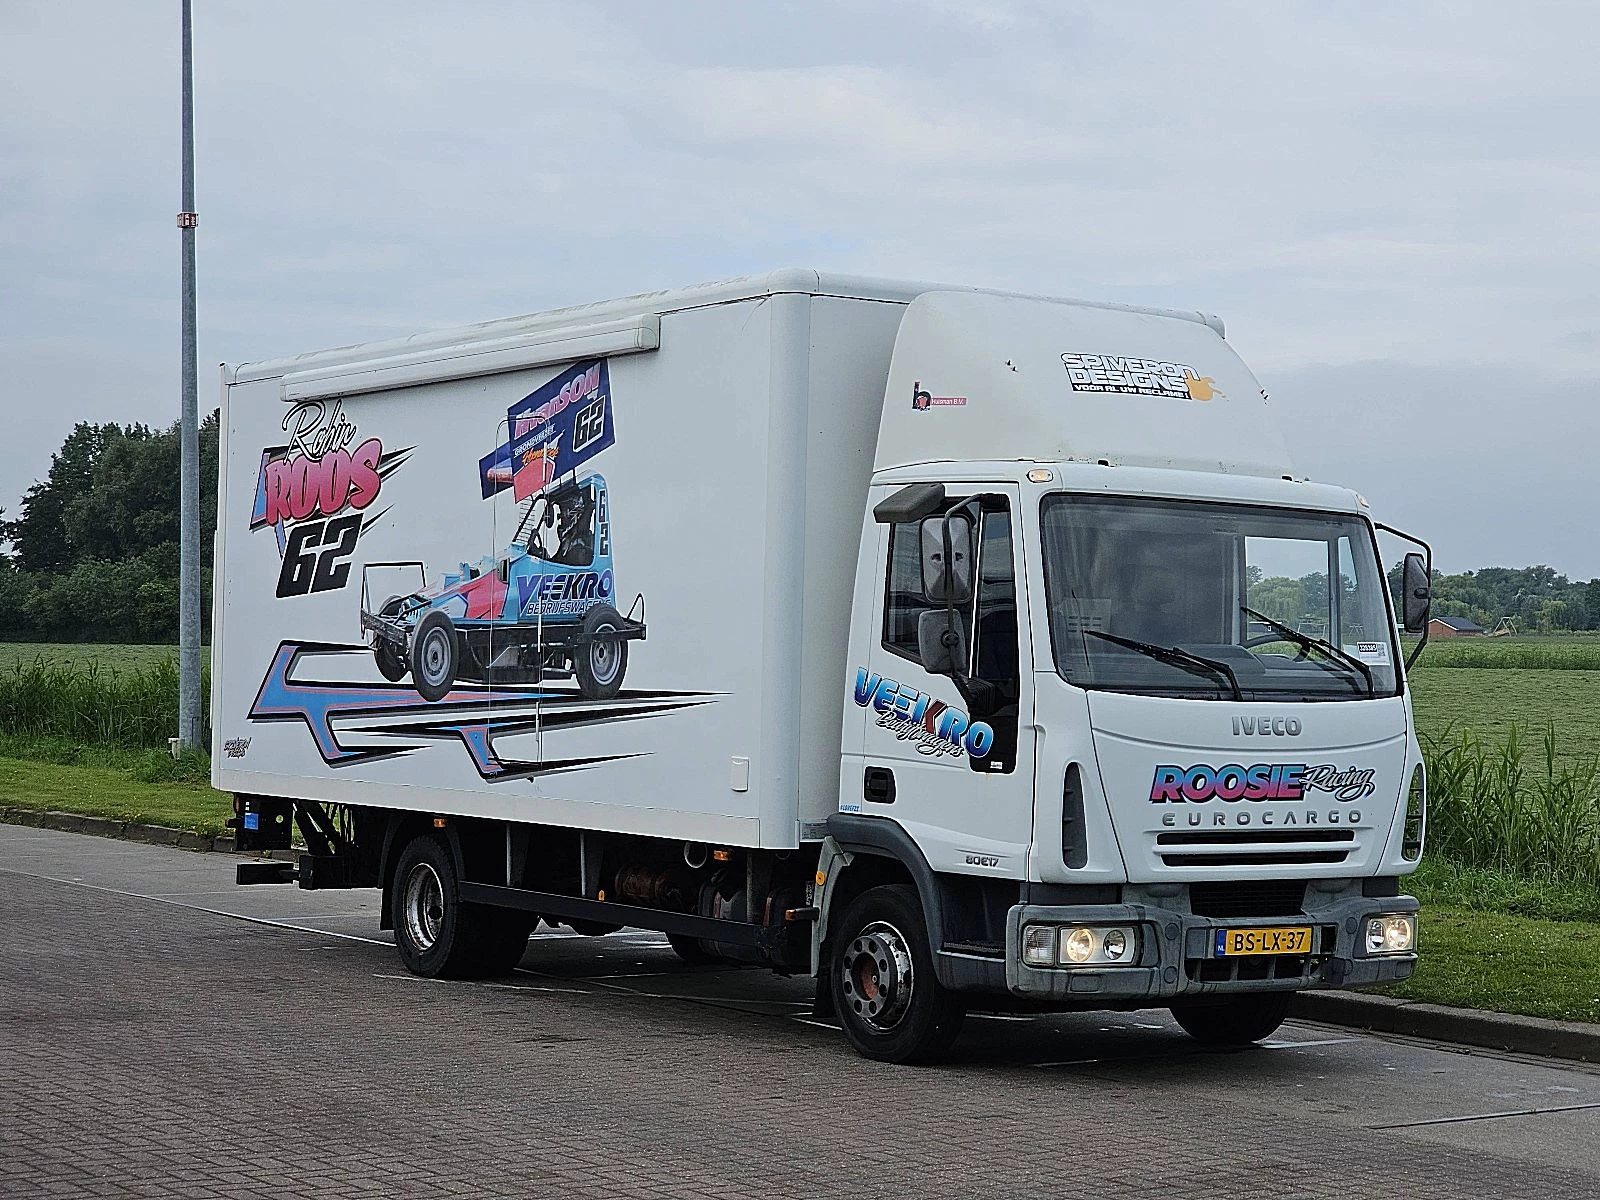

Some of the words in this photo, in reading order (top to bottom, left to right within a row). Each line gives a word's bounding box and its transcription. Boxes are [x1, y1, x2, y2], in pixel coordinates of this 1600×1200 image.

[1067, 368, 1189, 392] DESIGNS
[1074, 384, 1104, 392] VOOR
[282, 399, 357, 466] Robin
[574, 397, 605, 451] 62
[265, 437, 383, 526] ROOS
[275, 512, 364, 598] 62
[516, 569, 613, 616] VEEKRO
[854, 666, 994, 758] VEEKRO
[1231, 716, 1302, 736] IVECO
[1150, 763, 1306, 803] ROOSIE
[1299, 765, 1375, 802] Racing
[1162, 810, 1361, 826] EUROCARGO
[1234, 931, 1305, 952] BS-LX-37
